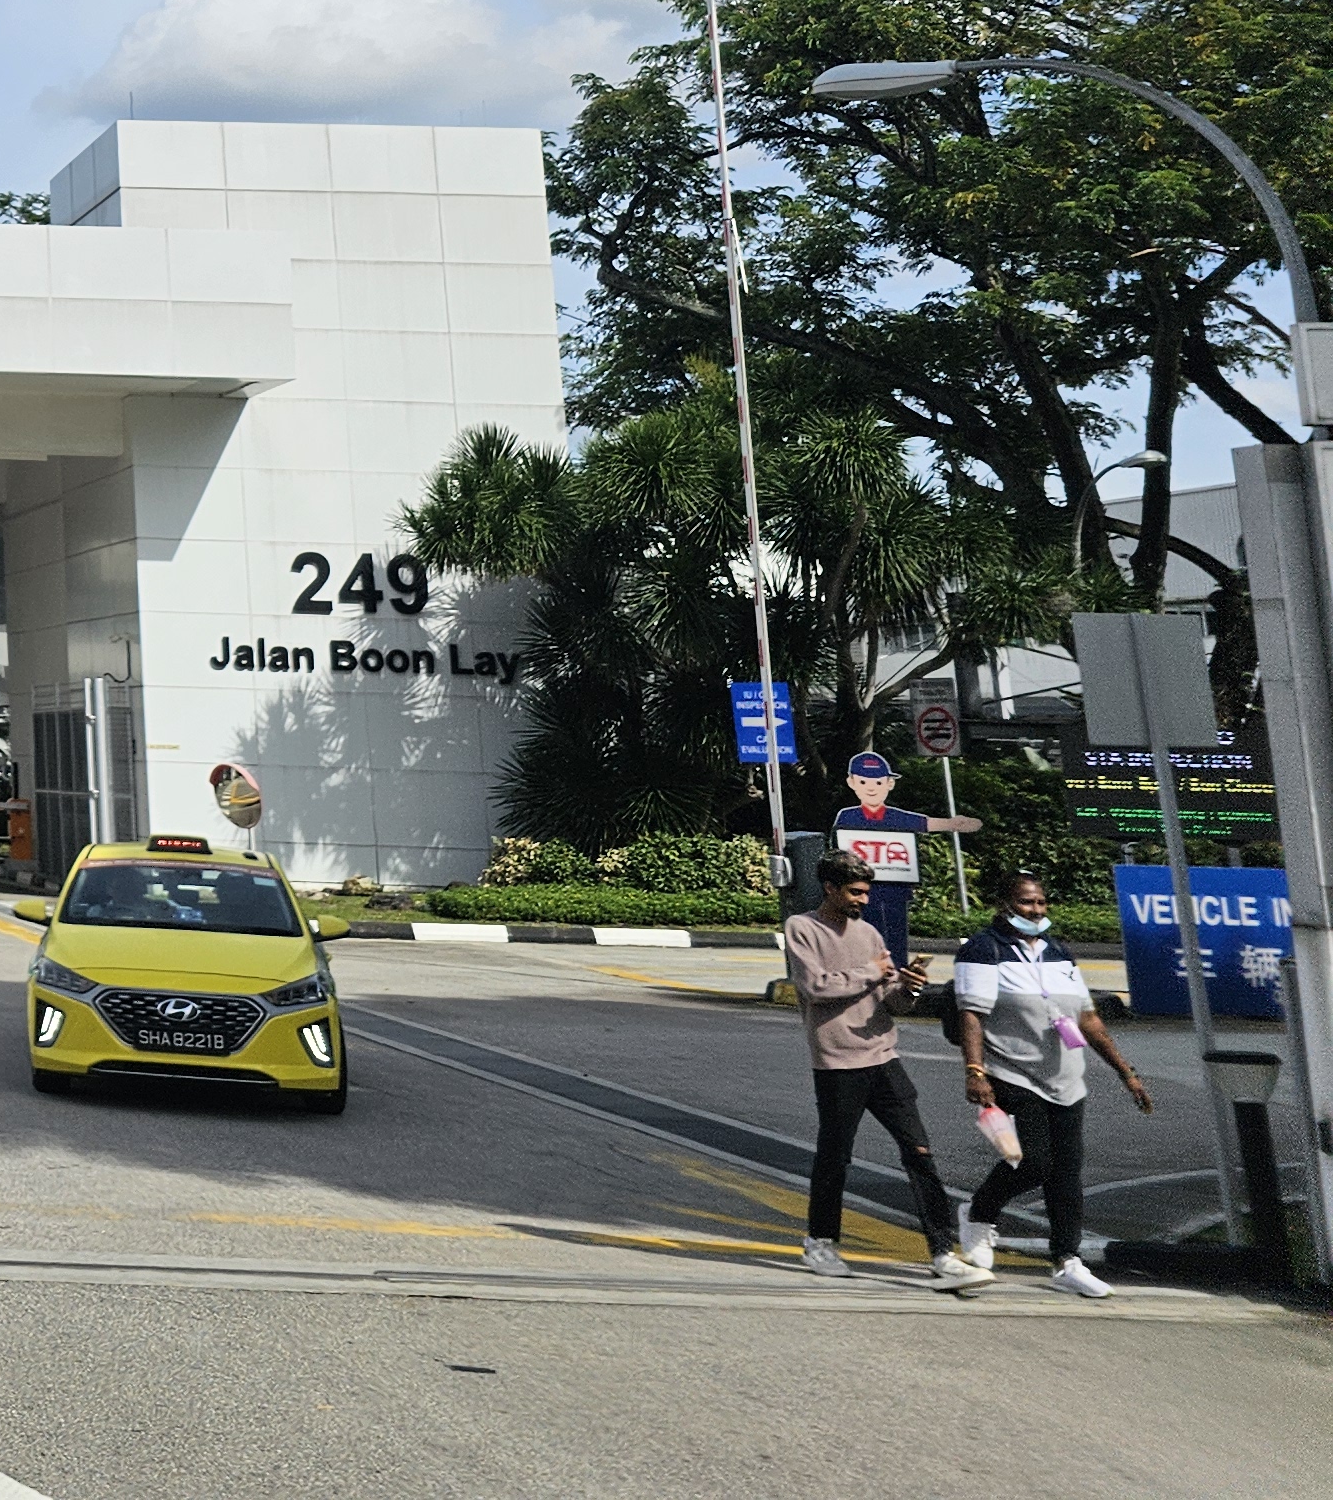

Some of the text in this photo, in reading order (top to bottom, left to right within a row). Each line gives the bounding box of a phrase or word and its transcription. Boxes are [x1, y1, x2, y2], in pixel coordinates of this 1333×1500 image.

[290, 551, 430, 616] 249
[209, 636, 521, 685] Jalan Boon Lay
